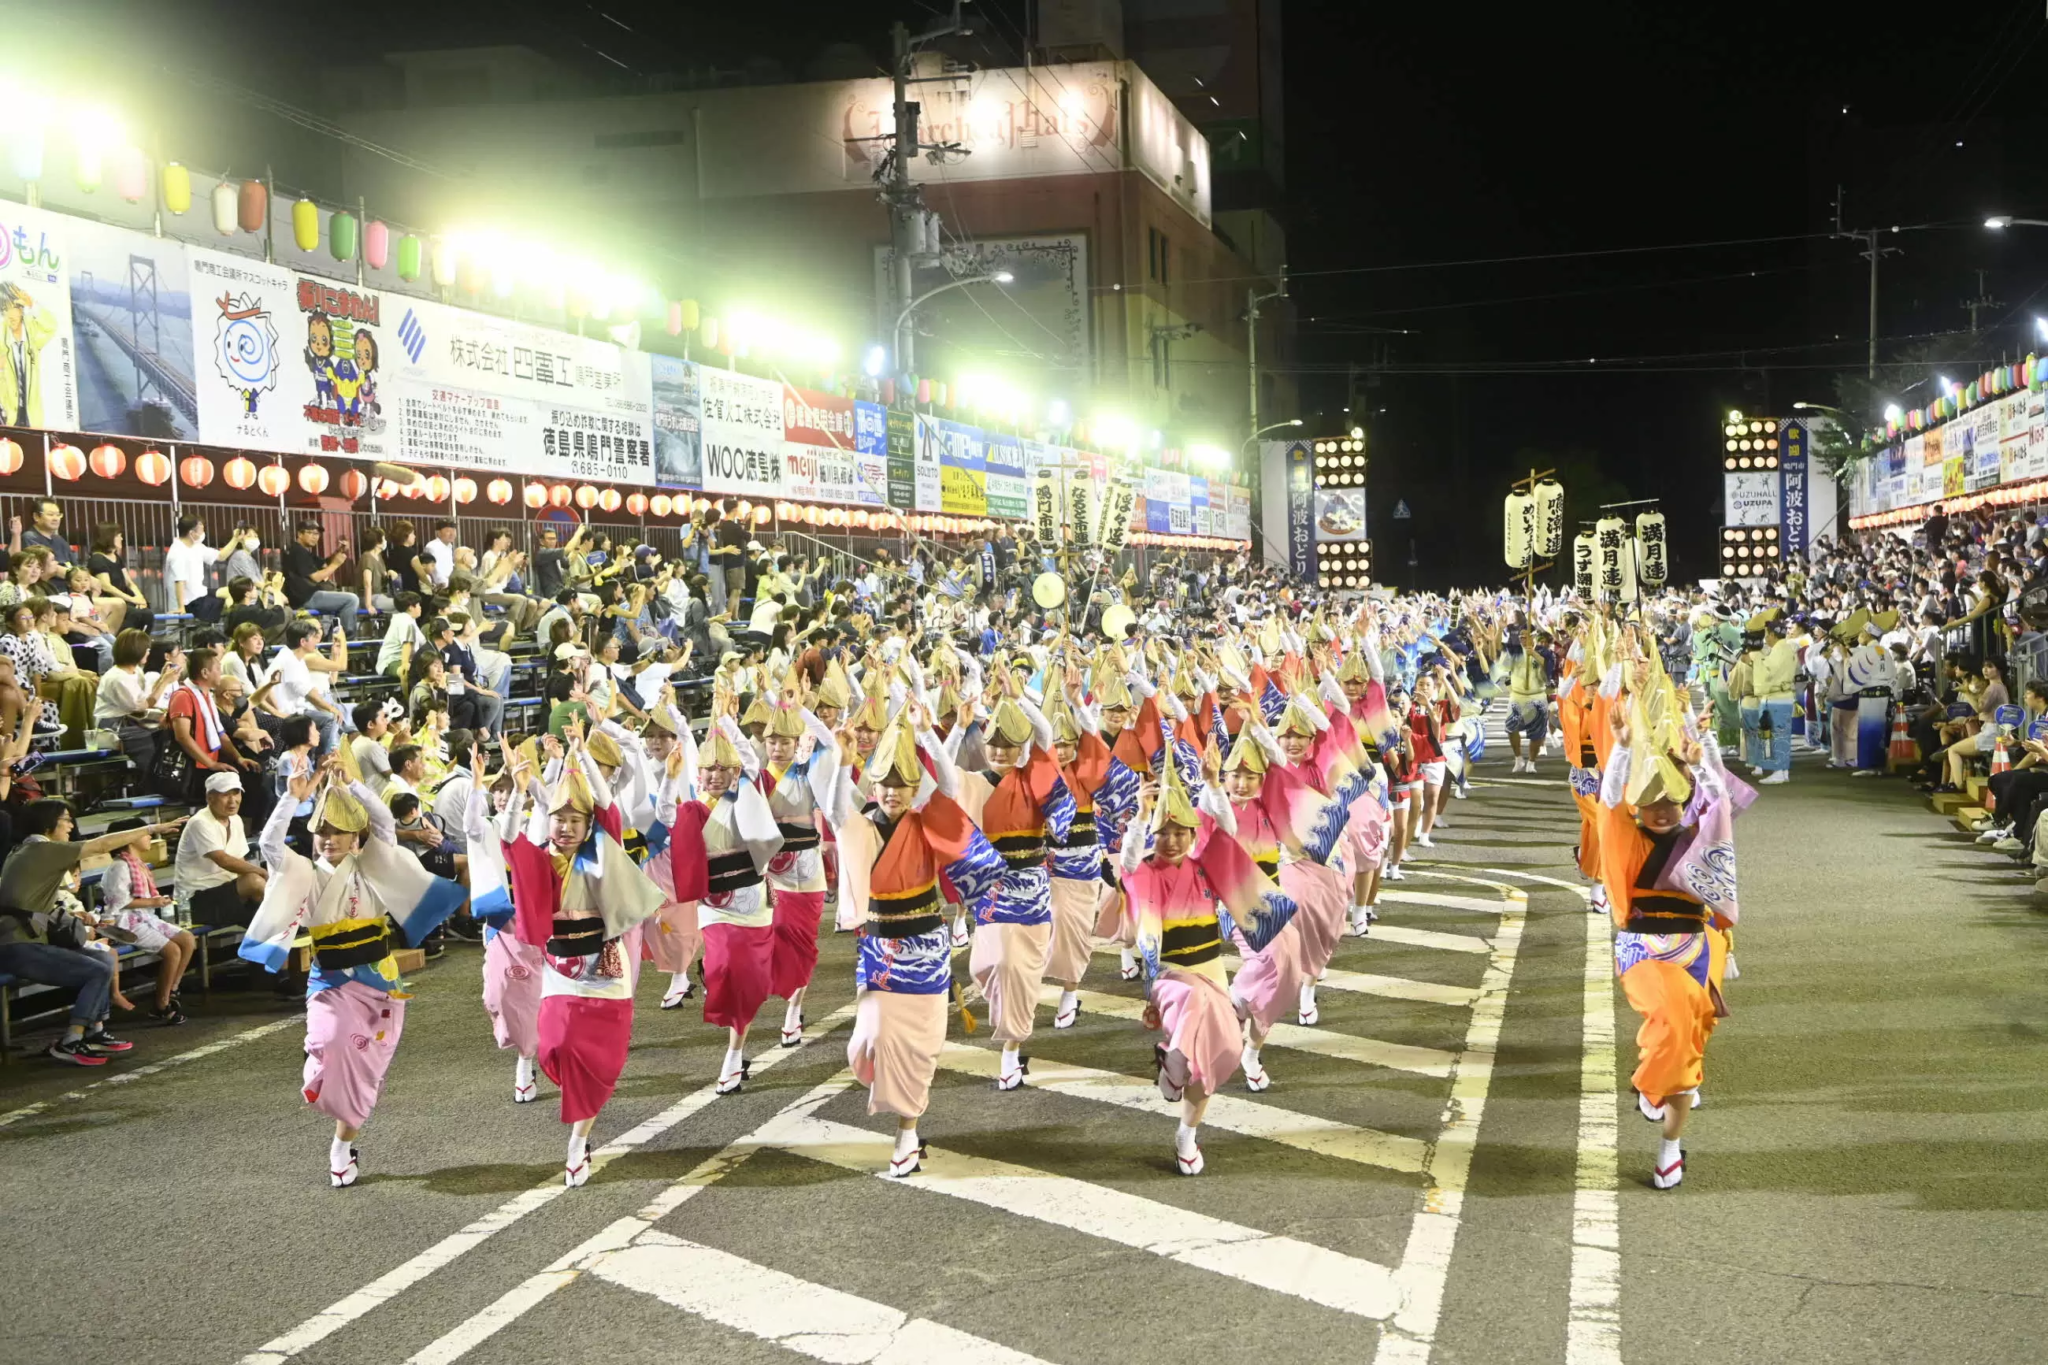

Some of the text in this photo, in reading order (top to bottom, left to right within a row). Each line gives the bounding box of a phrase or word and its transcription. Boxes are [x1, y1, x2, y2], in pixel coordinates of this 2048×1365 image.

[543, 427, 650, 468] 徳島県鳴門警察署
[787, 449, 818, 485] meiji
[1036, 484, 1055, 542] 鳴門市連
[1071, 486, 1090, 545] なると市連
[1739, 490, 1777, 499] UZUHALL
[1743, 499, 1773, 507] UZUPA
[1292, 492, 1309, 575] 阿波おどり
[1599, 528, 1623, 587] 満月連
[1641, 522, 1666, 580] 満月連
